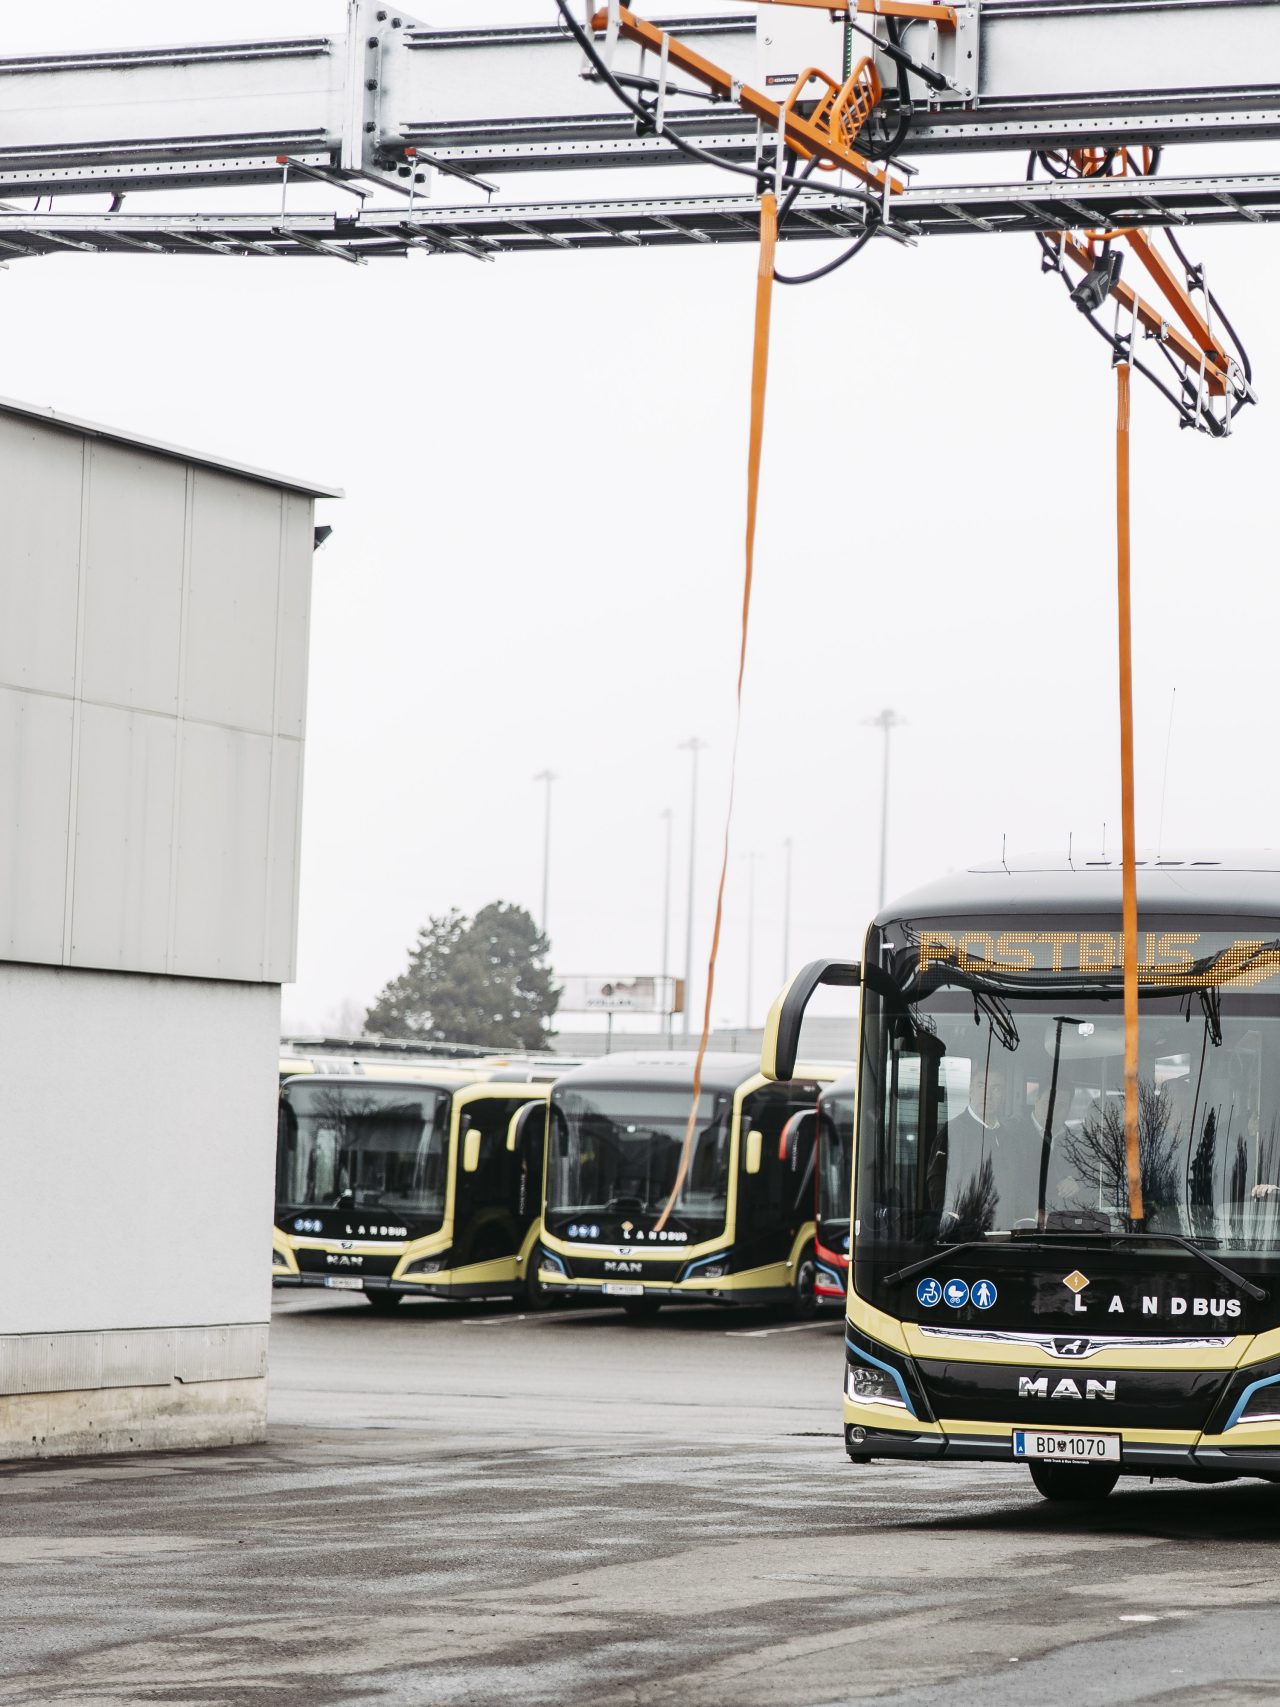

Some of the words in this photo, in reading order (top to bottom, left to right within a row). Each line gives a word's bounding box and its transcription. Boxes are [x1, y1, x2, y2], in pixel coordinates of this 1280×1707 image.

[919, 932, 1200, 973] POSTBUS
[603, 1261, 643, 1273] MAN
[1074, 1294, 1242, 1317] LANDBUS
[1018, 1376, 1117, 1401] MAN
[1036, 1436, 1056, 1453] BD
[1068, 1438, 1106, 1456] 1070
